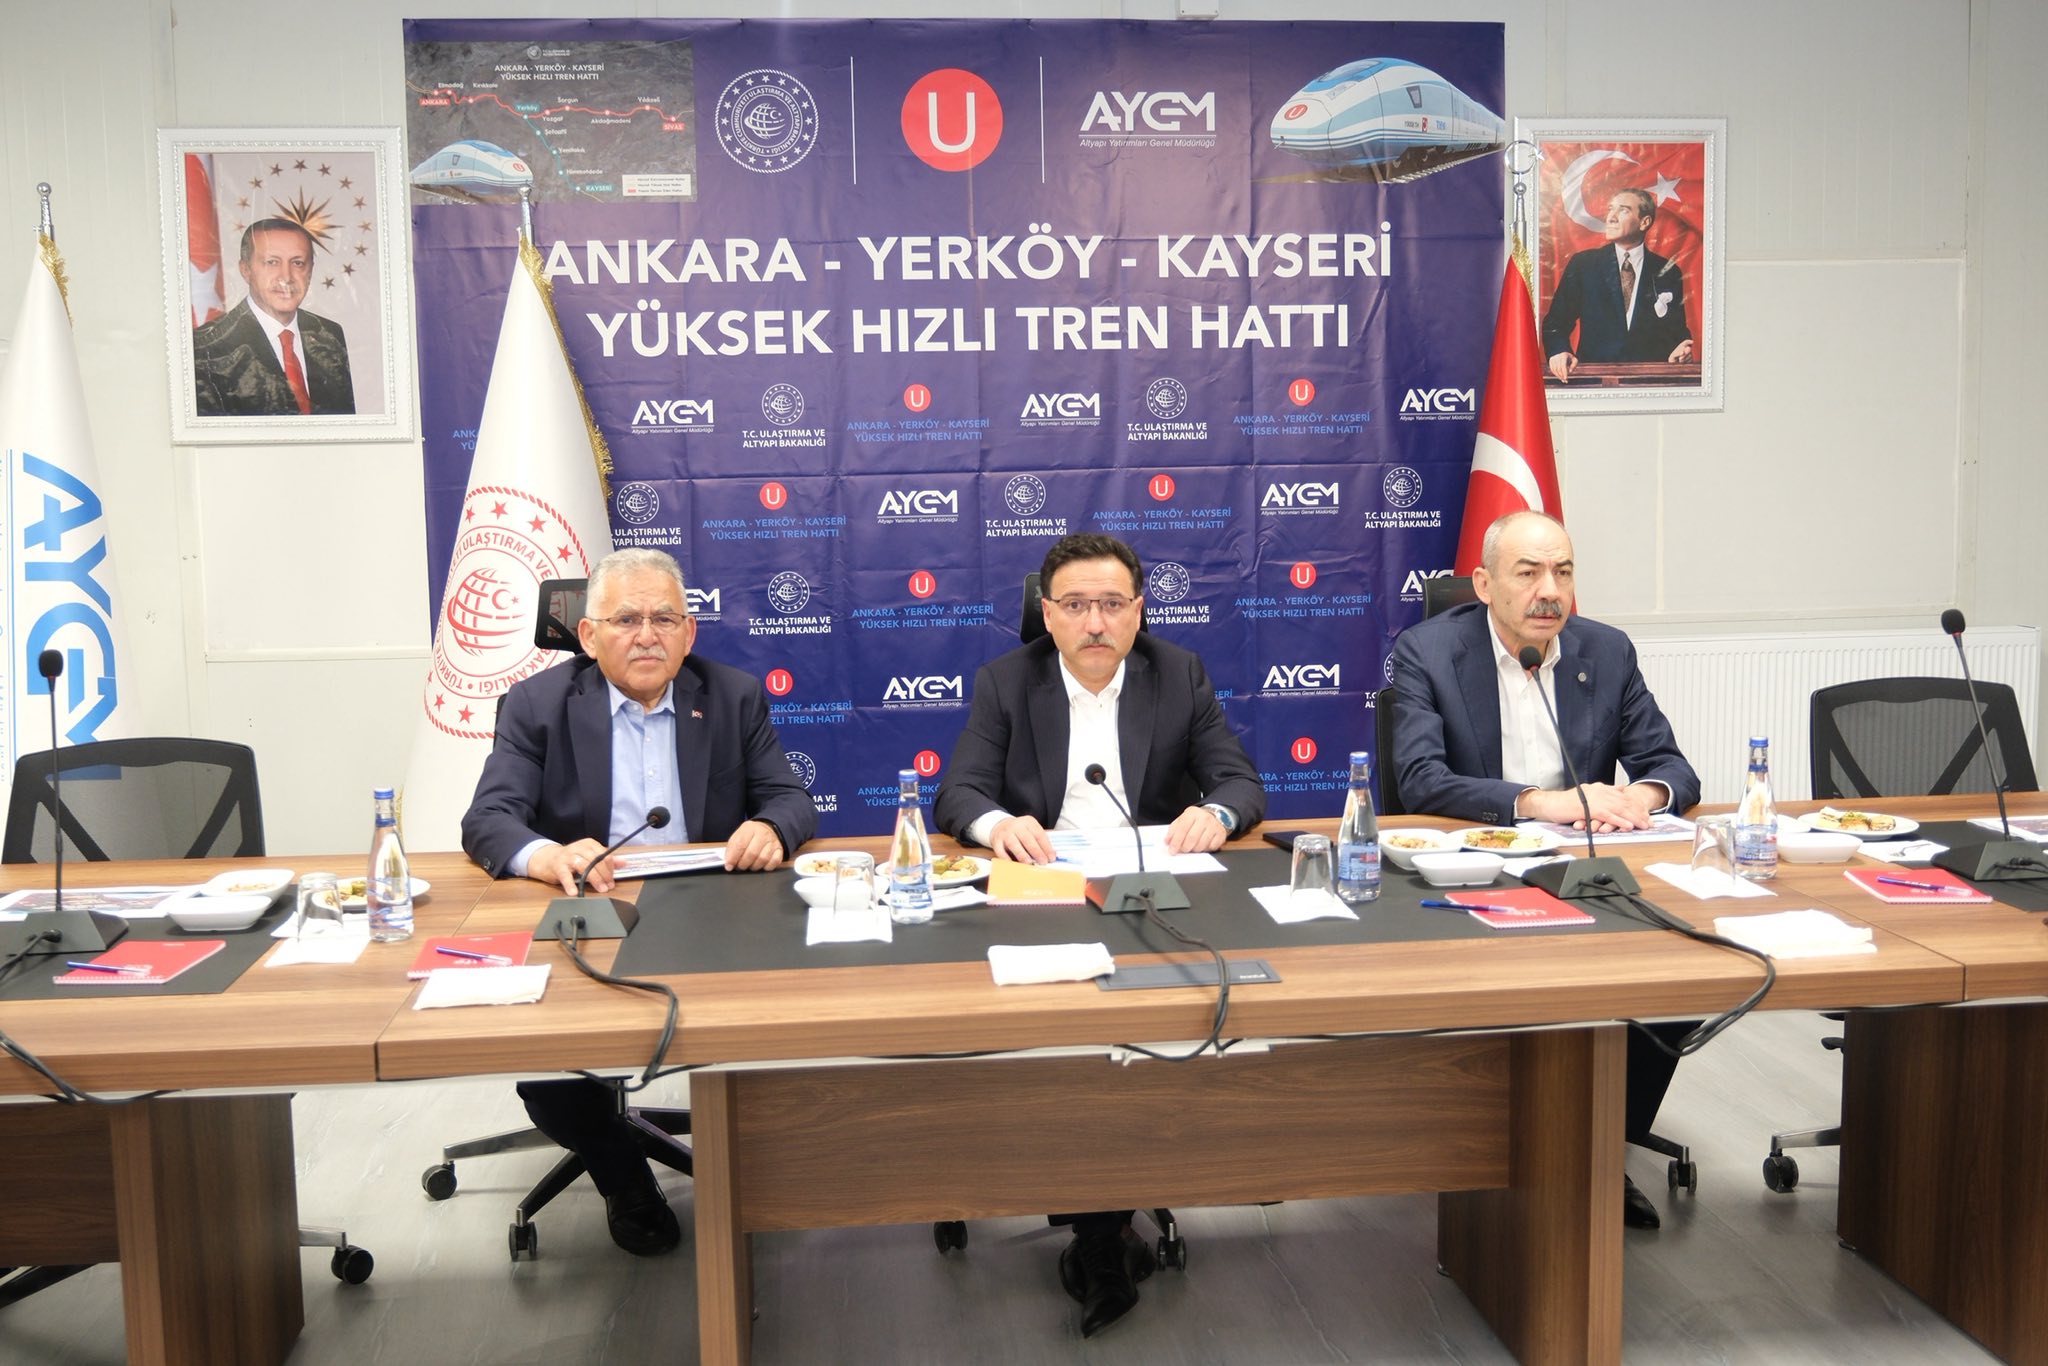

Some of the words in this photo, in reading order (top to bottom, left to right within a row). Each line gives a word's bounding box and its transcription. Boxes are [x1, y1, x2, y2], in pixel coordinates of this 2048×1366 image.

[535, 63, 566, 71] YERKÖY
[573, 63, 605, 71] KAYSERİ
[928, 92, 975, 154] U
[1080, 139, 1106, 148] Altyapı
[1150, 139, 1172, 147] Genel
[542, 237, 807, 284] ANKARA
[857, 223, 1104, 280] YERKÖY
[1158, 221, 1391, 278] KAYSERİ
[586, 299, 834, 357] YÜKSEK
[852, 307, 996, 353] HIZLI
[1015, 306, 1168, 350] TREN
[1191, 304, 1348, 348] HATTI
[1296, 385, 1308, 400] U
[911, 390, 924, 407] U
[1233, 416, 1274, 424] ANKARA
[1284, 413, 1322, 422] YERKÖY
[1332, 412, 1370, 422] KAYSERİ
[847, 422, 890, 430] ANKARA
[899, 418, 939, 429] YERKÖY
[949, 418, 989, 428] KAYSERİ
[1145, 423, 1193, 432] ULAŞTIRMA
[453, 430, 475, 438] ANK
[760, 430, 811, 439] ULAŞTIRMA
[1163, 430, 1207, 440] BAKANLIĞI
[1241, 426, 1279, 435] YÜKSEK
[1308, 426, 1333, 434] TREN
[1337, 425, 1362, 433] HATTI
[855, 432, 894, 442] YÜKSEK
[898, 433, 922, 441] HIZLI
[926, 432, 951, 440] TREN
[955, 432, 982, 440] HATTI
[743, 440, 777, 448] ALTYAPI
[780, 437, 825, 447] BAKANLIĞI
[1156, 480, 1168, 496] U
[766, 488, 780, 504] U
[1093, 511, 1135, 519] ANKARA
[1144, 508, 1183, 518] YERKÖY
[1192, 507, 1231, 517] KAYSERİ
[1381, 511, 1428, 520] ULAŞTIRMA
[703, 520, 746, 528] ANKARA
[755, 517, 796, 527] YERKÖY
[805, 516, 846, 526] KAYSERİ
[1003, 519, 1053, 528] ULAŞTIRMA
[1101, 521, 1139, 531] YÜKSEK
[1142, 522, 1165, 530] HIZLI
[1399, 519, 1440, 527] BAKANLIĞI
[615, 528, 667, 537] ULAŞTIRMA
[711, 530, 751, 540] YÜKSEK
[754, 531, 778, 539] HIZLI
[782, 530, 807, 538] TREN
[811, 529, 838, 537] HATTI
[986, 529, 1019, 537] ALTYAPI
[1022, 527, 1066, 536] BAKANLIĞI
[635, 536, 681, 545] BAKANLIĞI
[463, 532, 536, 562] ULAŞTIRMA
[536, 559, 552, 580] VE
[1297, 568, 1309, 584] U
[916, 578, 928, 593] U
[1235, 598, 1276, 606] ANKARA
[1285, 595, 1324, 605] YERKÖY
[1333, 594, 1371, 604] KAYSERİ
[852, 608, 895, 617] ANKARA
[904, 605, 944, 615] YERKÖY
[954, 603, 993, 614] KAYSERİ
[1147, 606, 1196, 616] ULAŞTIRMA
[1242, 608, 1280, 618] YÜKSEK
[1284, 609, 1306, 617] HIZLI
[1310, 608, 1334, 616] TREN
[766, 617, 817, 626] ULAŞTIRMA
[860, 619, 899, 628] YÜKSEK
[1166, 614, 1209, 624] BAKANLIĞI
[749, 627, 783, 635] ALTYAPI
[786, 625, 831, 634] BAKANLIĞI
[773, 675, 785, 691] U
[811, 700, 852, 712] KAYSERİ
[788, 715, 813, 724] TREN
[817, 715, 844, 723] HATTI
[1298, 743, 1310, 759] U
[920, 756, 933, 772] U
[1286, 770, 1324, 780] YERKÖY
[858, 786, 900, 795] ANKARA
[1264, 784, 1281, 792] SEK
[1310, 782, 1334, 790] TREN
